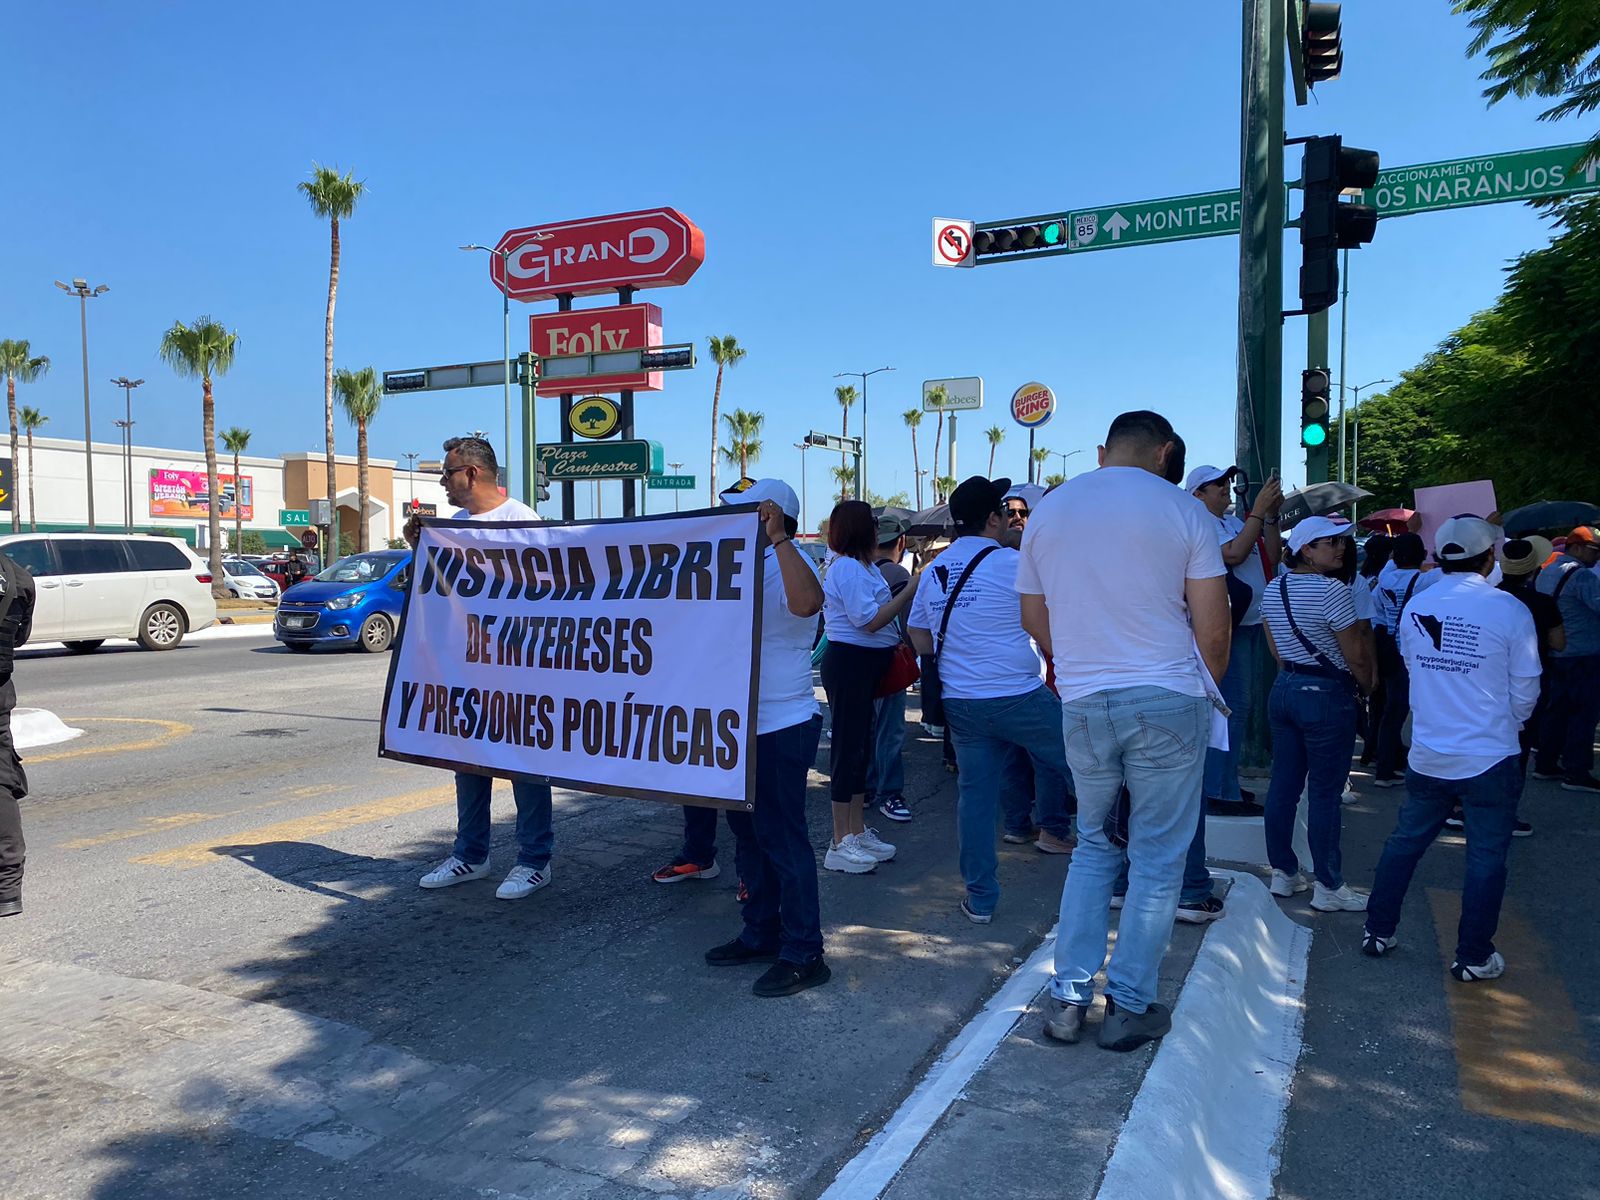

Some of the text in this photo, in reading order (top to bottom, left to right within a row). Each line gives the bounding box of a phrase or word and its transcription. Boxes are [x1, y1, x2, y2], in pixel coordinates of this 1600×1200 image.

[1374, 160, 1494, 187] ACCIONAMIENTO
[1415, 165, 1566, 204] NARANJOS
[1078, 224, 1094, 236] 85
[1135, 201, 1241, 233] MONTERR
[507, 227, 670, 283] GRAND
[1015, 390, 1049, 407] BURGER
[1016, 398, 1051, 418] KING
[541, 447, 588, 464] Plaza
[552, 461, 638, 476] Campestre
[286, 513, 308, 522] SAL
[418, 538, 745, 600] JUSTICIA LIBRE
[466, 614, 653, 676] DE INTERESES
[398, 681, 740, 770] Y PRESIONES POLÍTICAS
